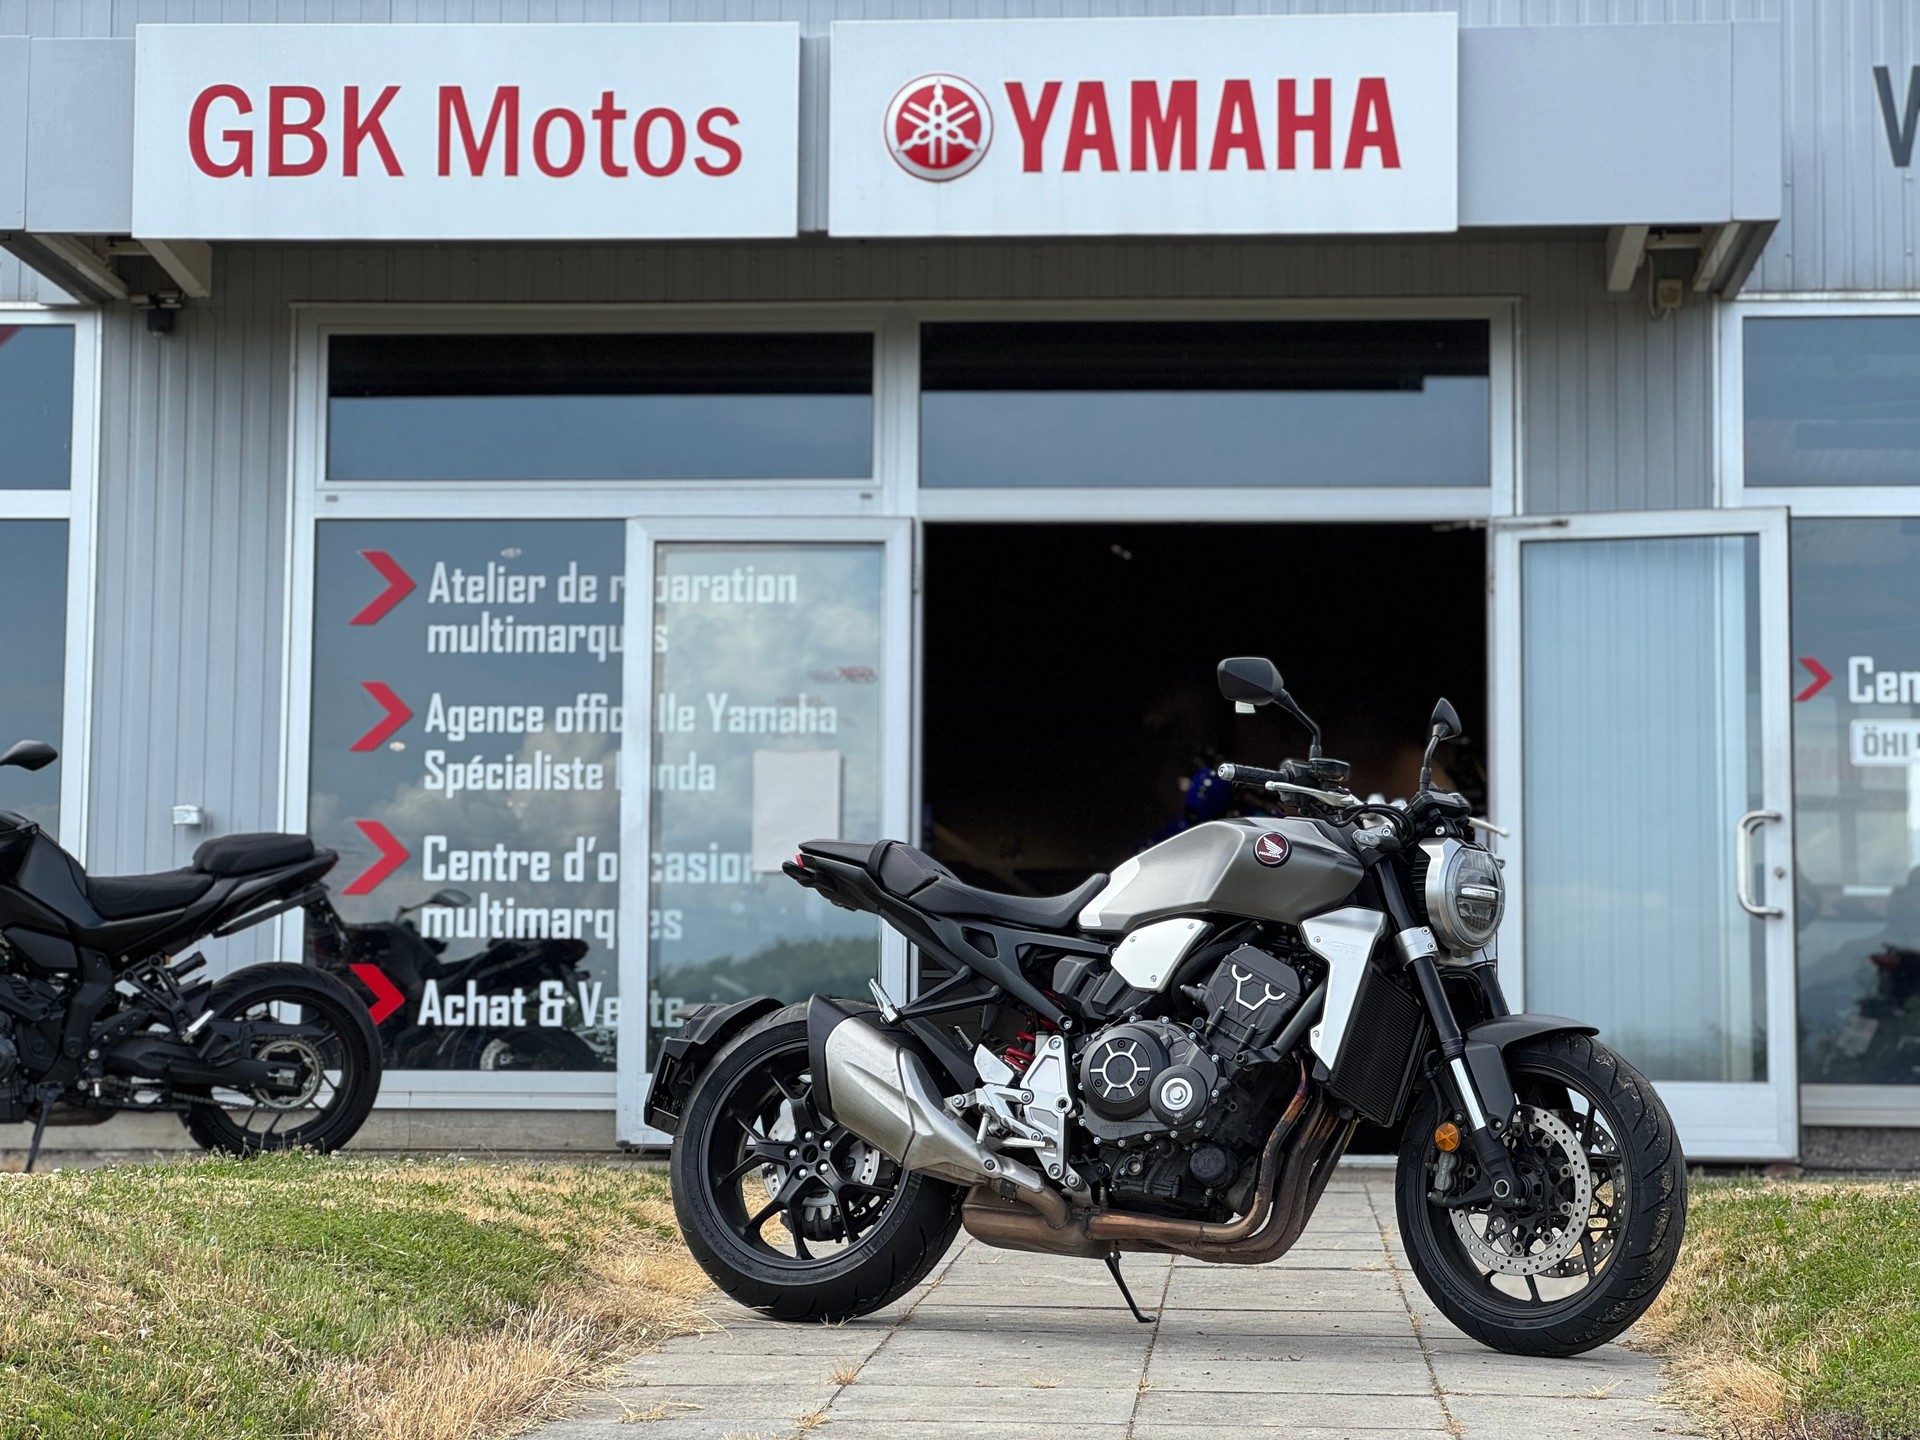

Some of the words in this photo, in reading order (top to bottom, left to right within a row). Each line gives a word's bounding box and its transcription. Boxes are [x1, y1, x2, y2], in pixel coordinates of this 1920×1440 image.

[188, 83, 405, 178] GBK
[436, 85, 744, 178] Motos
[1003, 77, 1402, 173] YAMAHA
[427, 561, 547, 604] Atelier
[557, 561, 598, 604] de
[427, 611, 669, 662] multimarqus
[425, 693, 544, 742] Agence
[555, 692, 696, 734] officlle
[706, 692, 838, 735] Yamaha
[424, 749, 604, 798] Spécialiste
[615, 751, 717, 791] nda
[422, 835, 551, 883] Centre
[421, 892, 683, 949] multimarqes
[417, 979, 527, 1027] Achat
[538, 979, 566, 1027] &
[577, 981, 685, 1028] Vete
